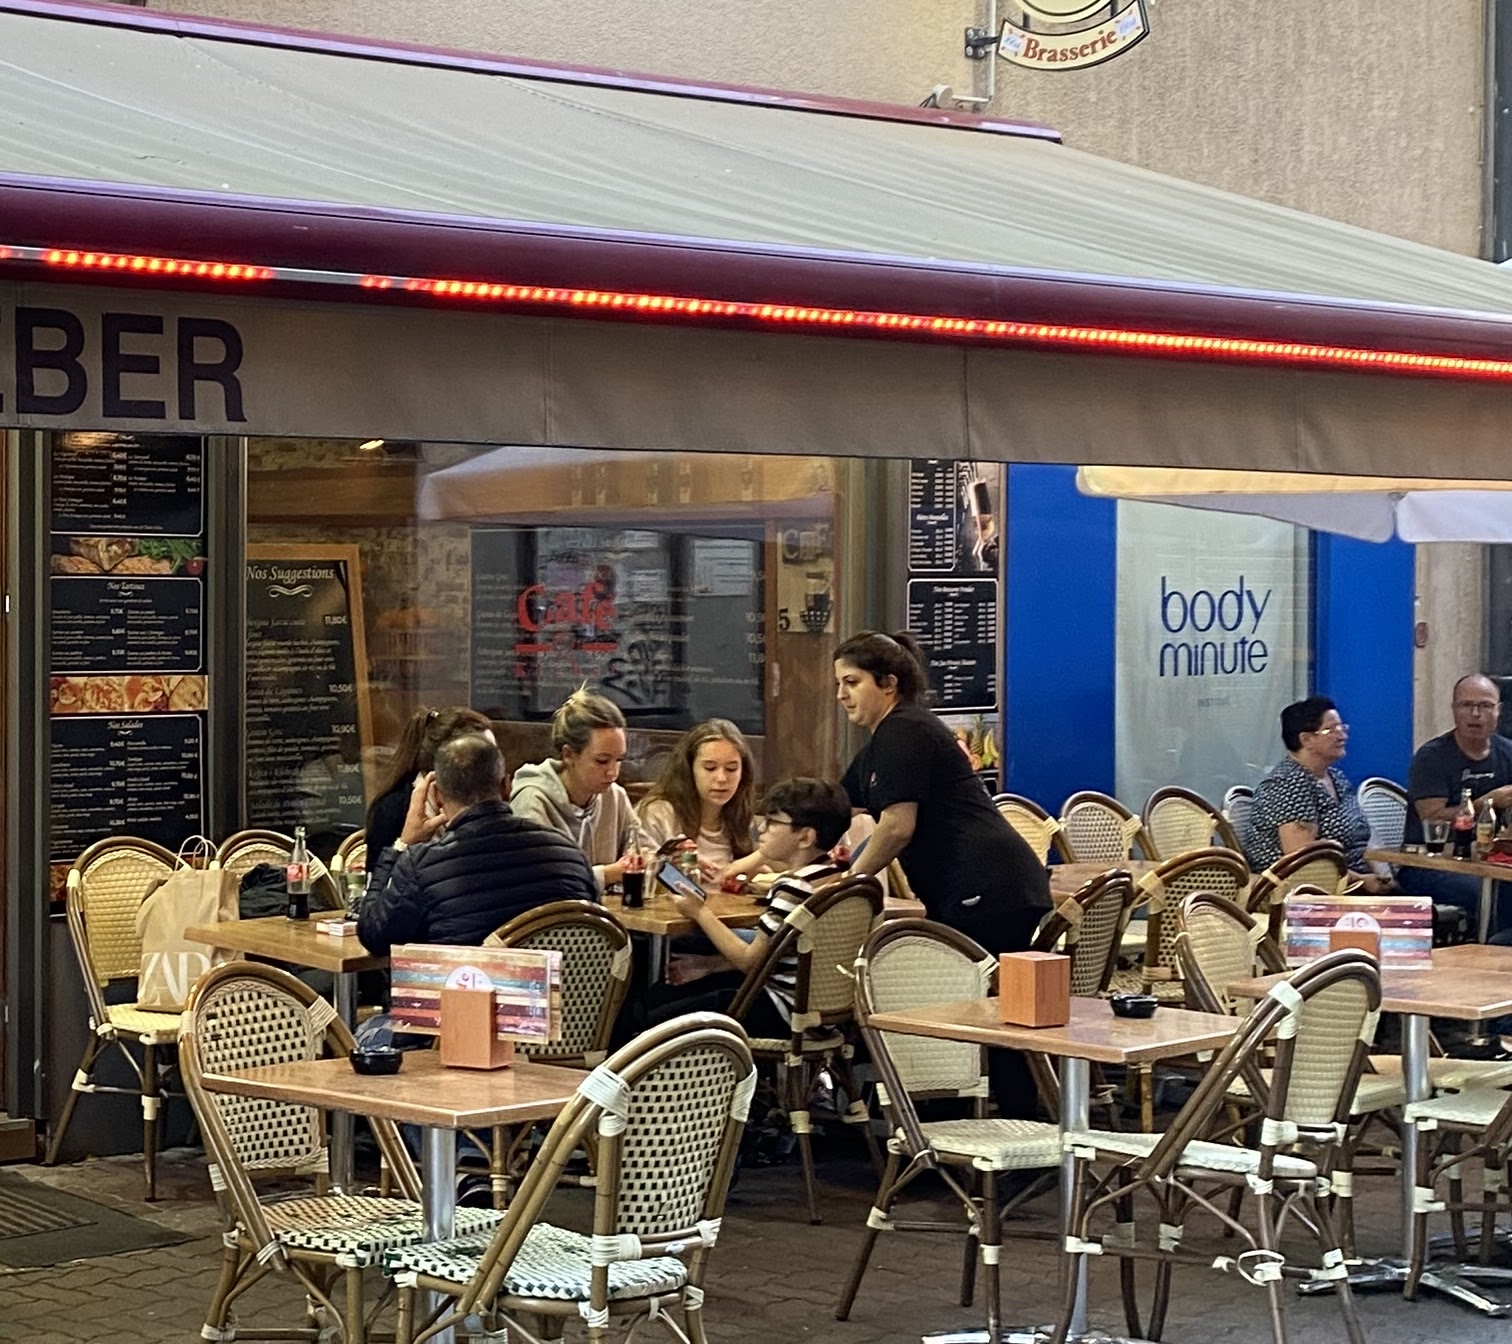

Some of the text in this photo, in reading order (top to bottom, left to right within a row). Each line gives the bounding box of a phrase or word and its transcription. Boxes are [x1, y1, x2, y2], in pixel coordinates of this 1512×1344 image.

[1022, 29, 1118, 62] Brasserie
[246, 566, 335, 584] Nos Suggestions
[1160, 575, 1272, 635] body
[1159, 636, 1269, 677] minute
[137, 951, 212, 1006] ZAR
